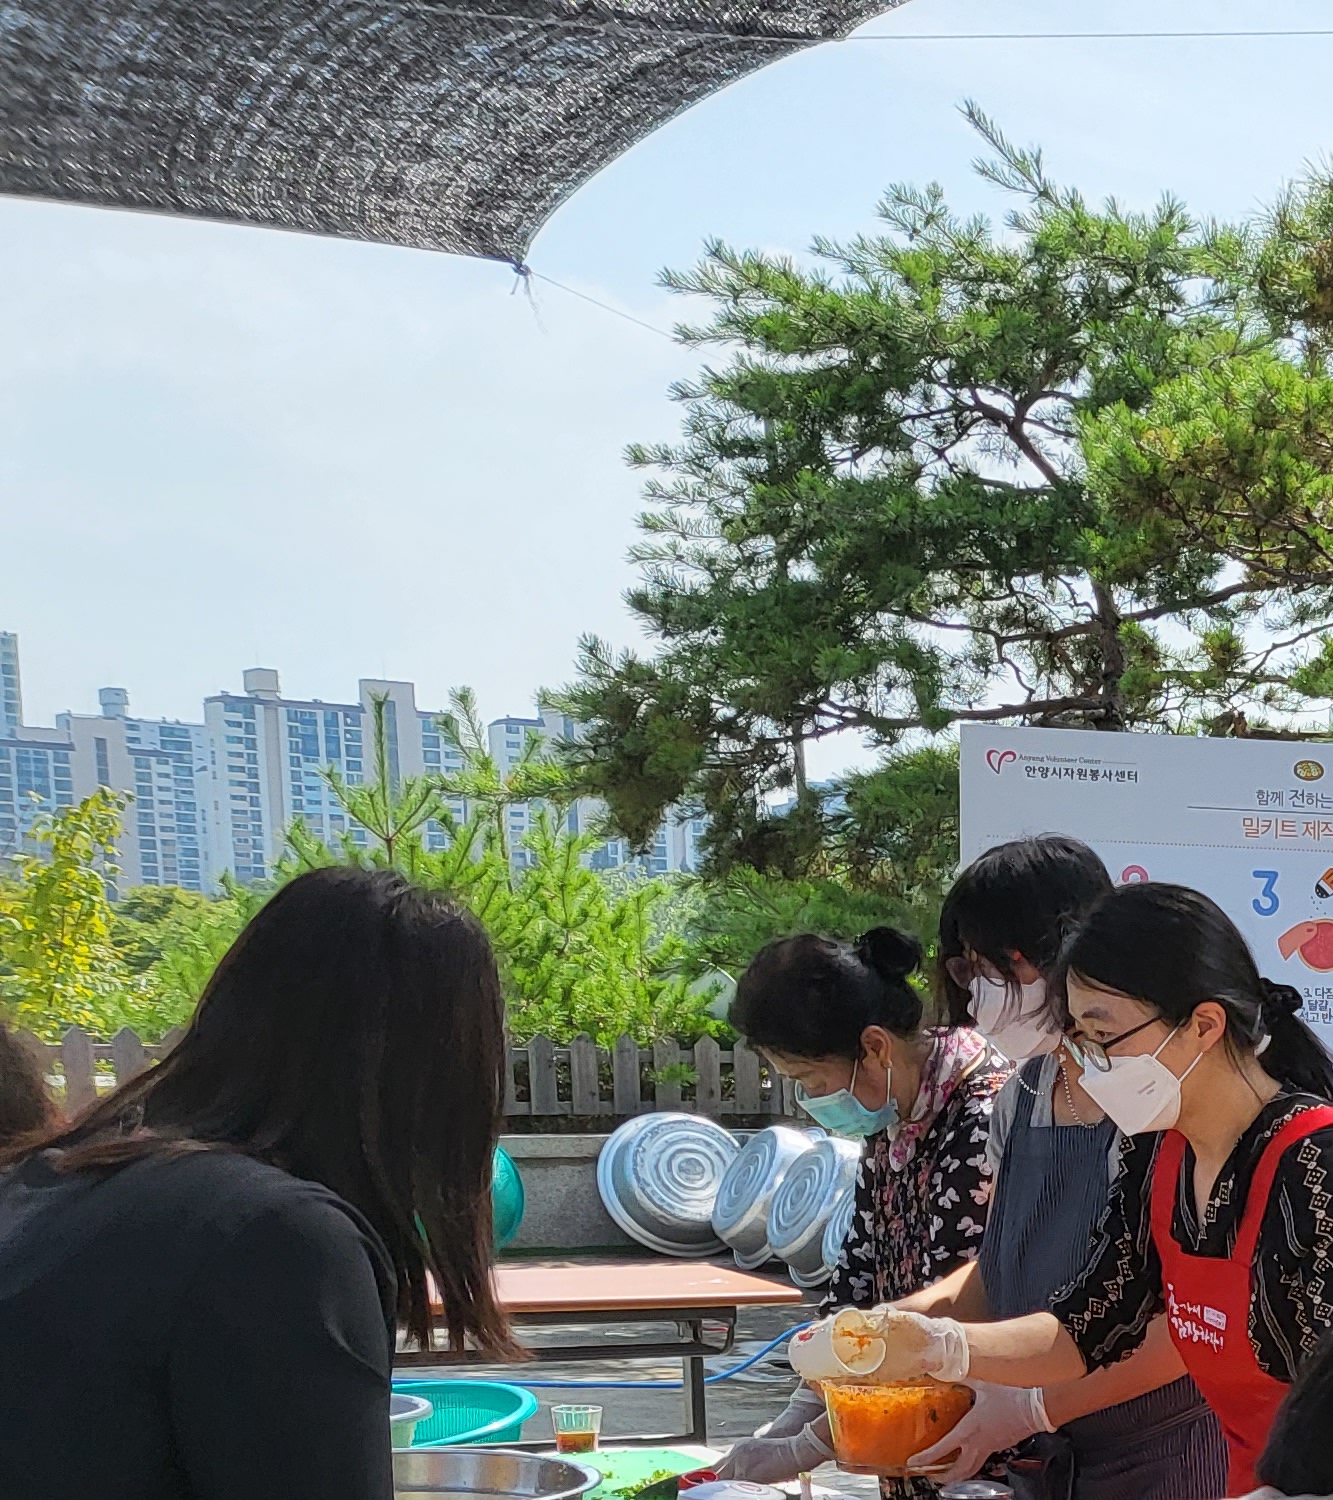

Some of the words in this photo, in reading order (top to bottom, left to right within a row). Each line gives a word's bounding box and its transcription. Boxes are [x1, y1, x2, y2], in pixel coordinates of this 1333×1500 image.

[1018, 754, 1044, 763] Anyang
[1046, 755, 1078, 763] Volunteer
[1025, 765, 1138, 784] 안양시자원봉사센터
[1256, 789, 1284, 807] 함께
[1288, 788, 1333, 809] 전하는
[1242, 816, 1298, 839] 밀키트
[1252, 870, 1279, 916] 3
[1303, 987, 1313, 998] 3.
